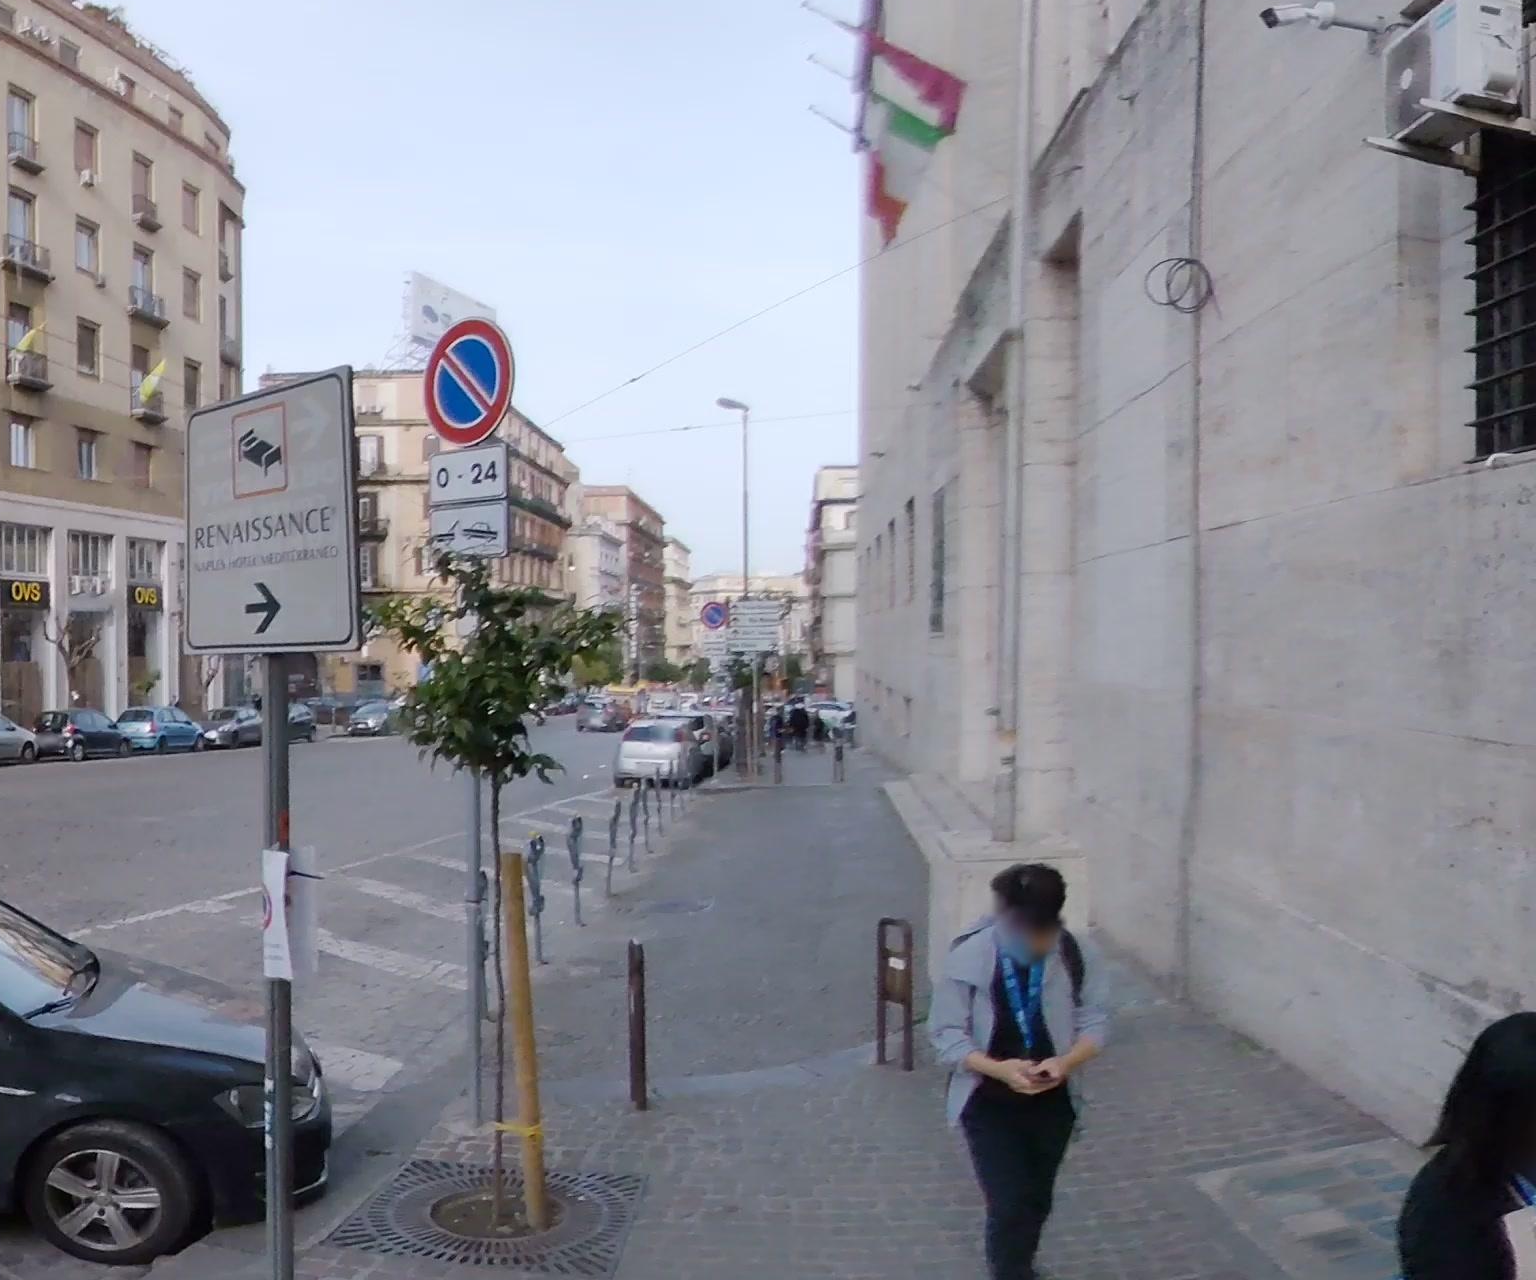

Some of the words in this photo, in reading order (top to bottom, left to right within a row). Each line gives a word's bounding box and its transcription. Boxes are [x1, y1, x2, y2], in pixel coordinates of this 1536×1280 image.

[437, 467, 449, 488] 0
[471, 460, 497, 485] 24
[194, 506, 331, 550] RENAISSANCE
[11, 581, 41, 601] OVS
[135, 586, 158, 604] OVS
